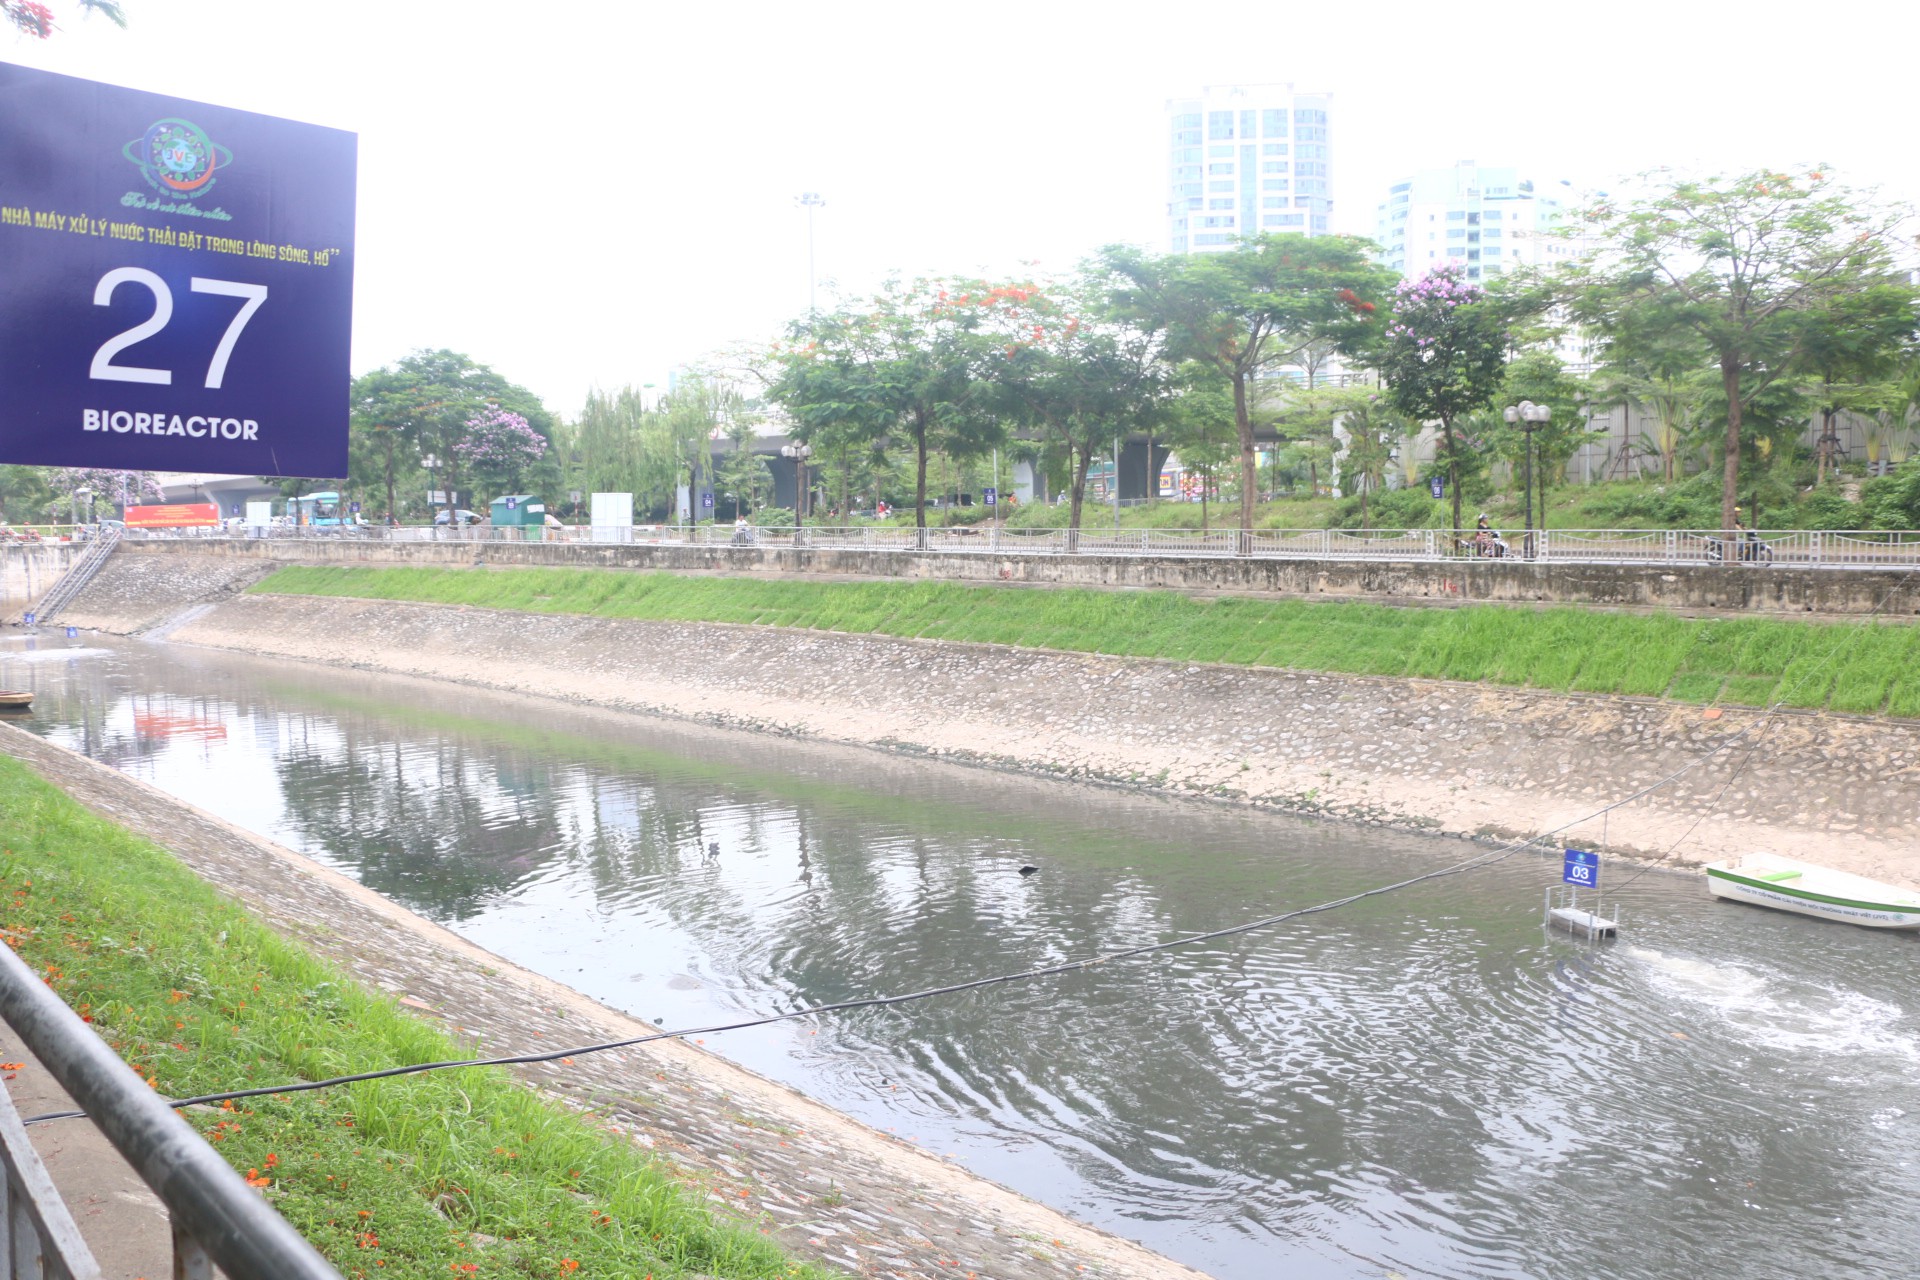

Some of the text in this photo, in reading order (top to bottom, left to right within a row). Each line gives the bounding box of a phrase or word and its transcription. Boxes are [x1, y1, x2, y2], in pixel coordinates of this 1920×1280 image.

[166, 148, 193, 163] JVE
[1, 206, 32, 227] NHÀ
[35, 211, 66, 231] MÁY
[69, 213, 89, 234] XỬ
[91, 218, 108, 237] LÝ
[110, 222, 145, 242] NƯỚC
[147, 226, 176, 246] THẢI
[178, 231, 204, 252] ĐẶT
[205, 235, 244, 255] TRONG
[247, 240, 277, 260] LÒNG
[279, 244, 312, 266] SÔNG,
[89, 266, 269, 389] 27
[82, 408, 259, 441] BIOREACTOR
[1572, 865, 1589, 880] 03
